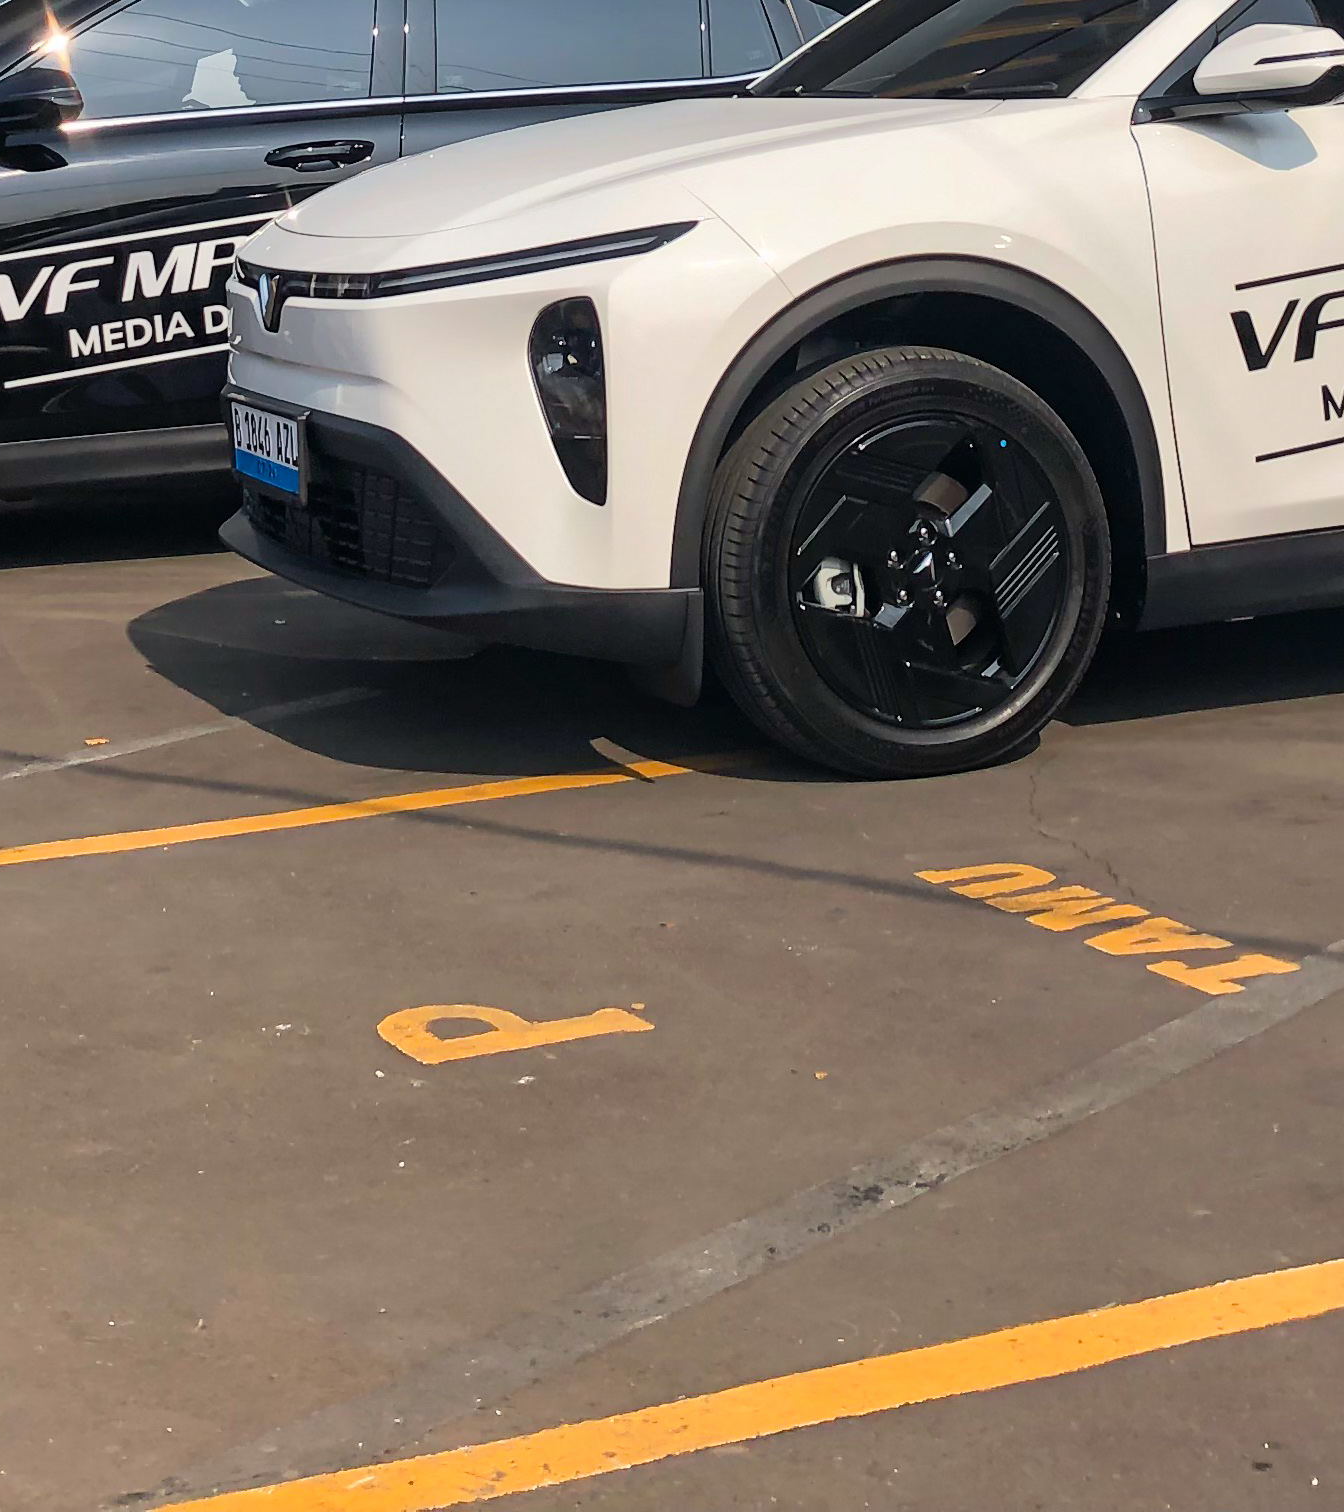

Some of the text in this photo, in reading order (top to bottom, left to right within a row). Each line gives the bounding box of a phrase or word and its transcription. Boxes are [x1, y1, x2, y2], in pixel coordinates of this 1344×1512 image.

[121, 235, 248, 304] MP
[68, 310, 196, 359] MEDIA
[234, 407, 242, 448] B
[244, 411, 271, 458] 1846
[913, 862, 1303, 997] TAMU
[376, 1003, 656, 1065] P
